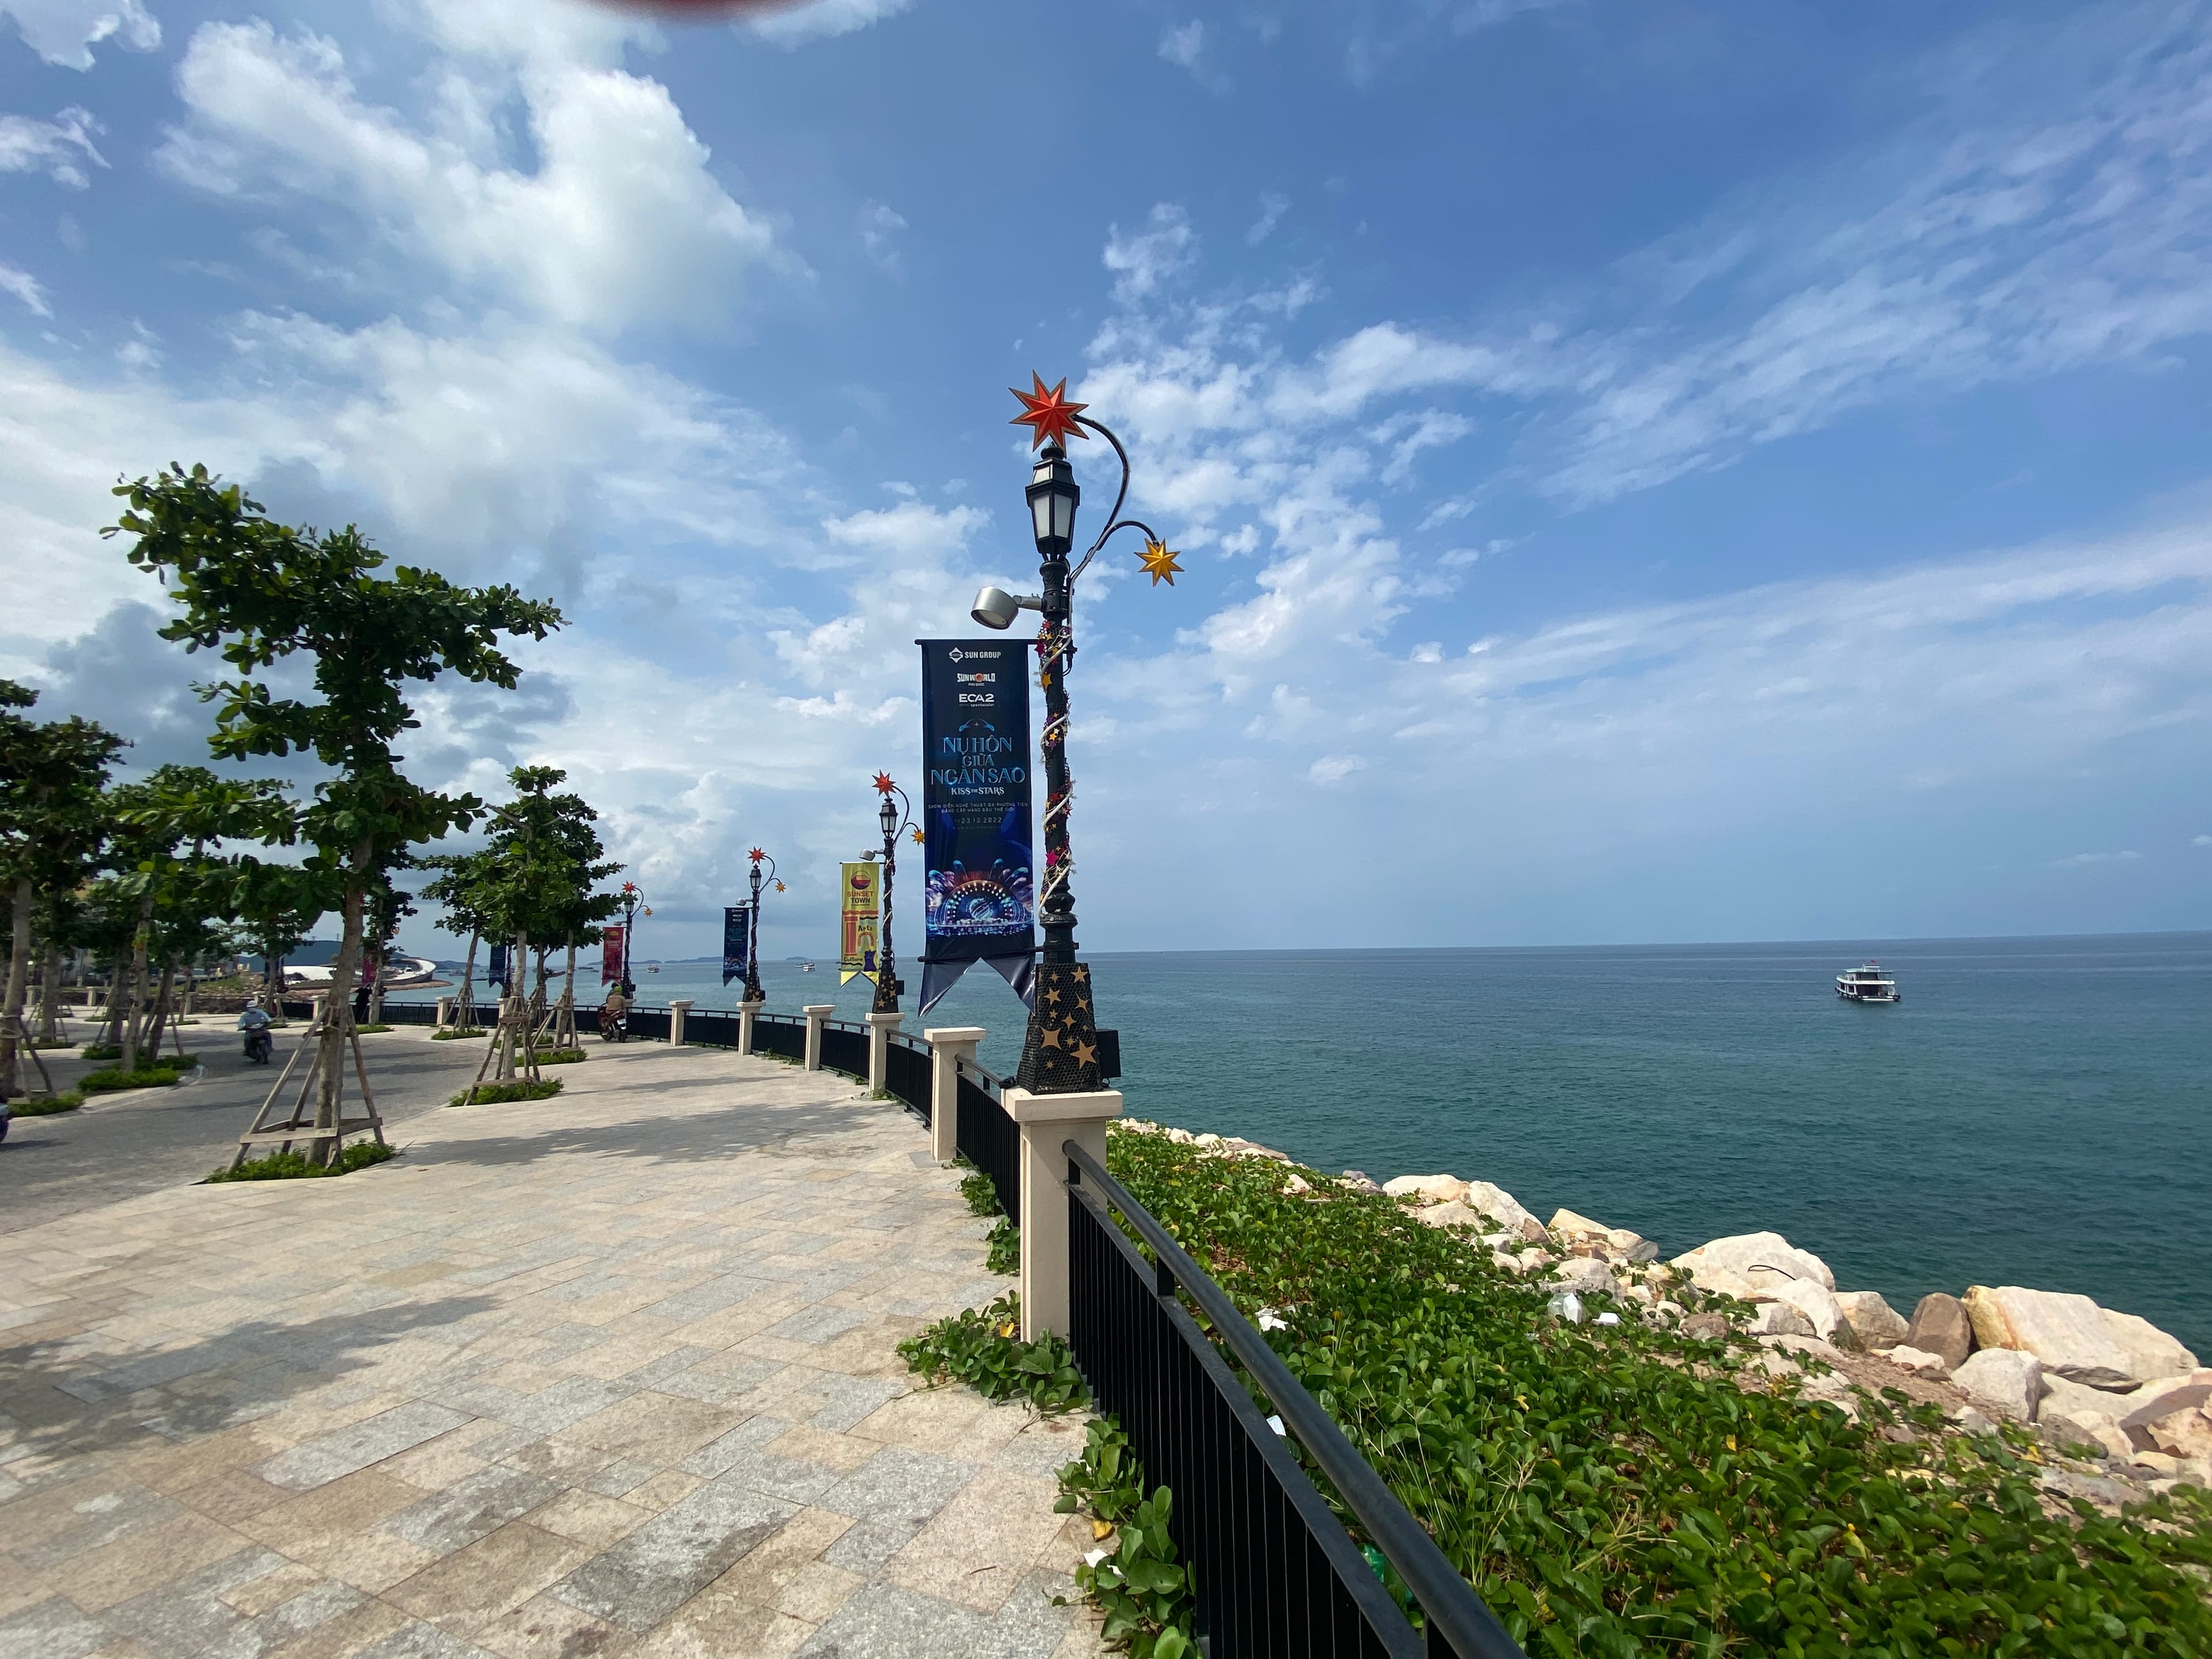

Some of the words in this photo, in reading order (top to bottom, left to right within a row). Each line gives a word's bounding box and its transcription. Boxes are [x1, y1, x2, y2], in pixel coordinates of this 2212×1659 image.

[959, 694, 995, 703] ECA2
[971, 734, 1012, 752] HÔN
[988, 767, 1025, 783] SAO
[951, 787, 971, 795] KISS
[979, 787, 1005, 796] STARS
